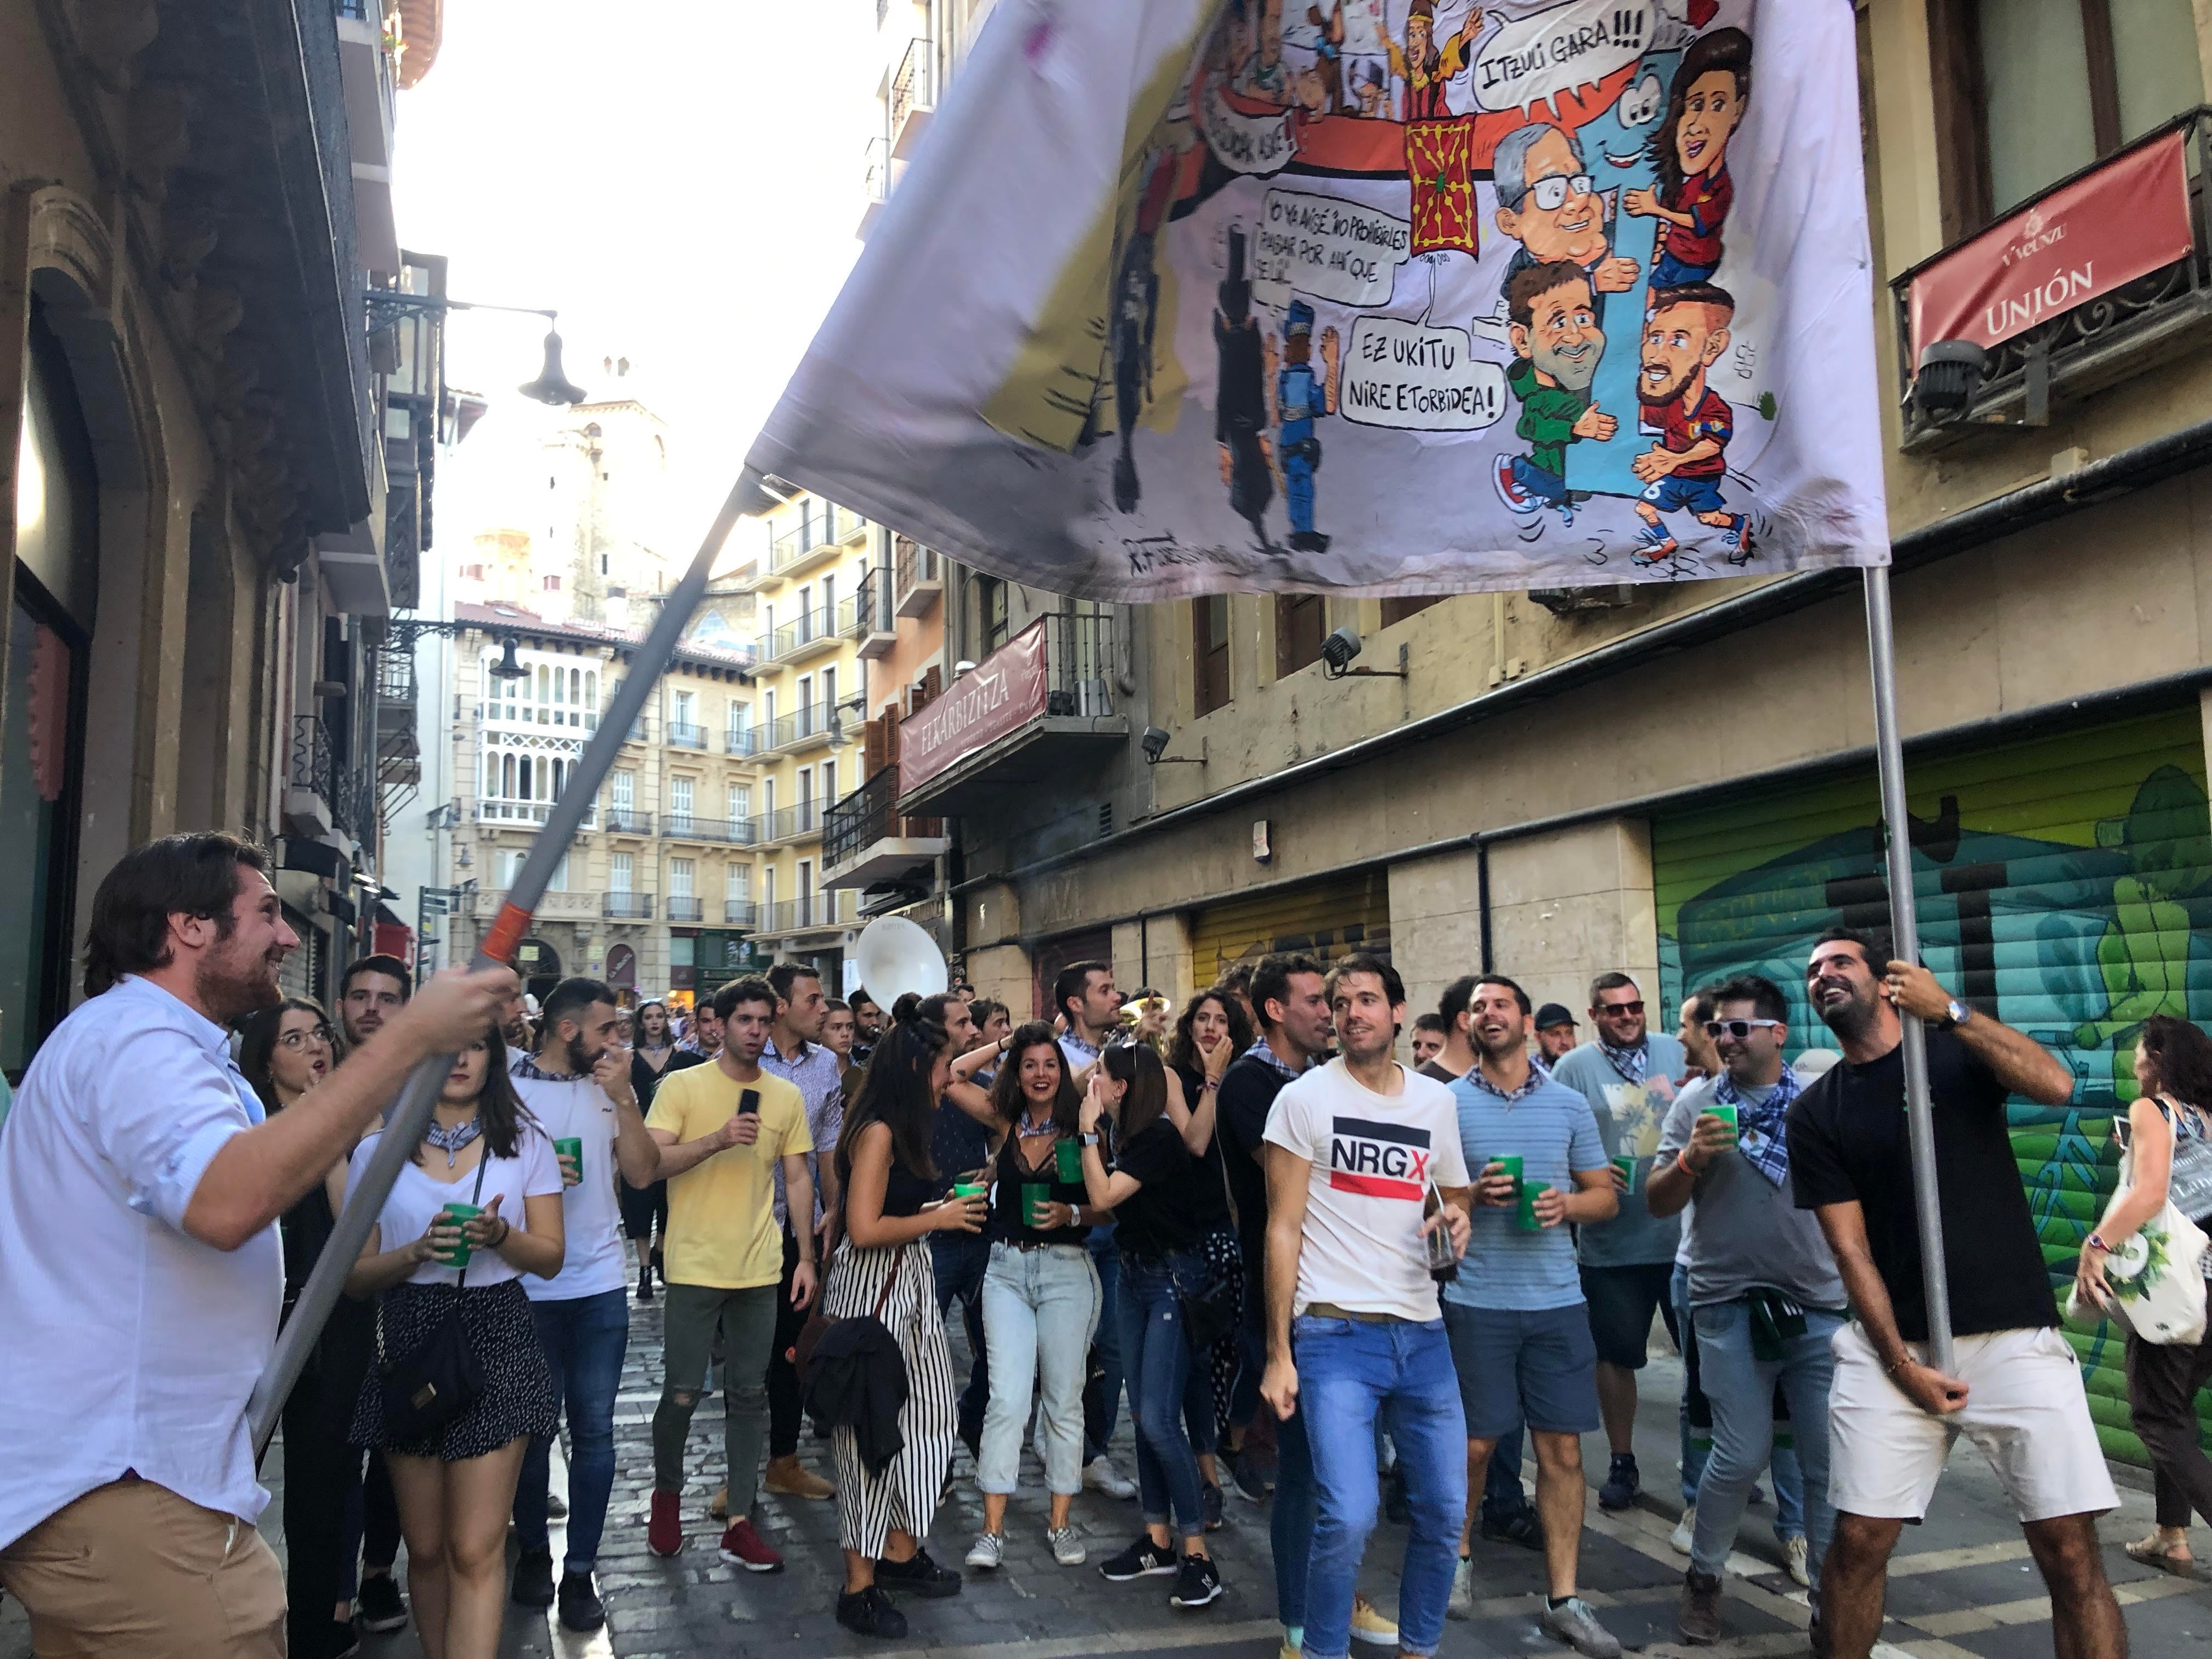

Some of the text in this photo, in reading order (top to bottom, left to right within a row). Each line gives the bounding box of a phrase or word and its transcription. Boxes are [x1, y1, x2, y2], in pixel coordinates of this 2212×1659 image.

[1349, 257, 1378, 283] QUE
[1987, 261, 2094, 335] UNIÓN
[1362, 332, 1387, 363] EZ
[921, 668, 1010, 757] ELKARBIZITZA
[1330, 1137, 1430, 1182] NRGX
